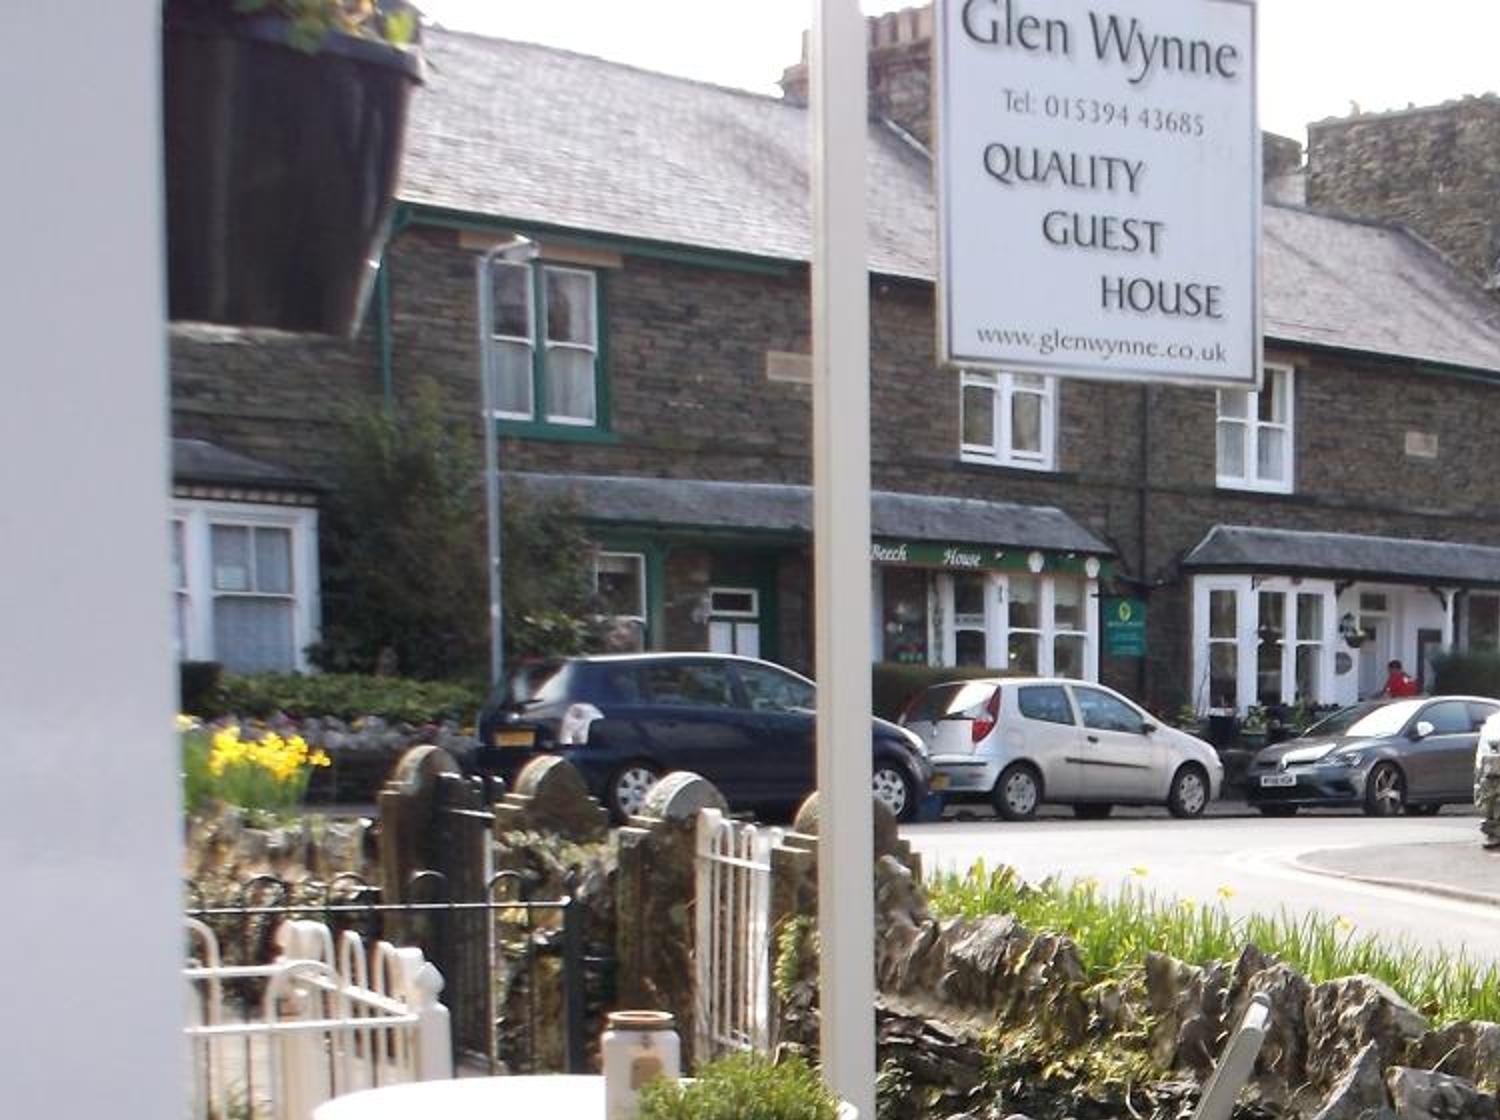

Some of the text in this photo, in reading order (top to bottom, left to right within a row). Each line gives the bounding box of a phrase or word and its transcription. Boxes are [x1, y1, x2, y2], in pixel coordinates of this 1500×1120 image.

[961, 0, 1239, 85] Glen Wynne
[1044, 95, 1129, 127] 015394
[1137, 107, 1205, 137] 43685
[982, 142, 1144, 193] QUALITY
[1041, 210, 1165, 254] GUEST
[1100, 275, 1223, 320] HOUSE
[976, 328, 1227, 363] www.glenwynne.co.uk
